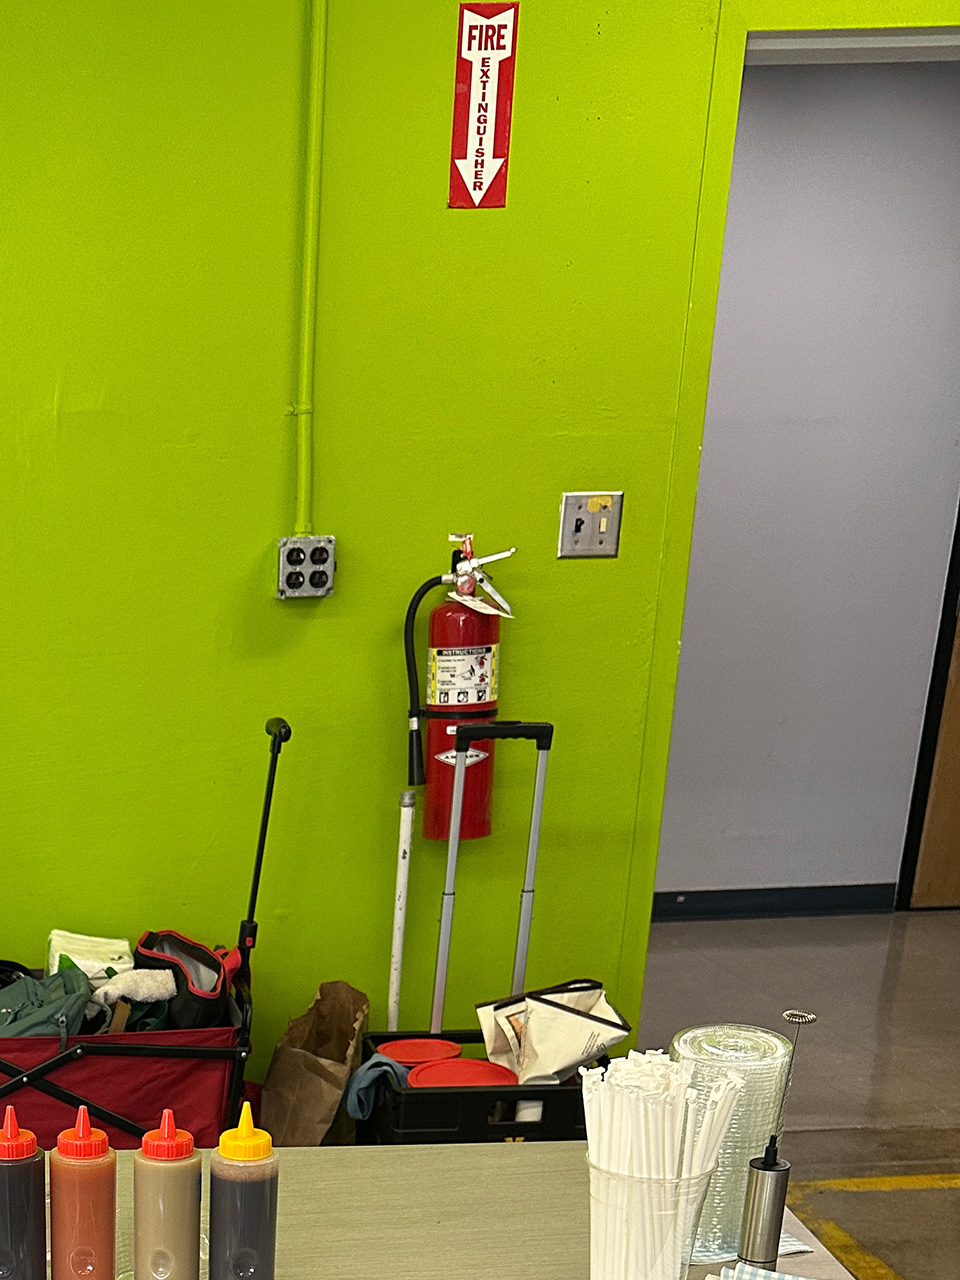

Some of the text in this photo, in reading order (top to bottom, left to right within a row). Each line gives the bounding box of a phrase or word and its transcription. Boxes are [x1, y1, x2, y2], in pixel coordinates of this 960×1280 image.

[467, 24, 508, 51] FIRE
[473, 57, 491, 191] EXTINGUISHER
[442, 648, 486, 657] INSTRUCTIONS
